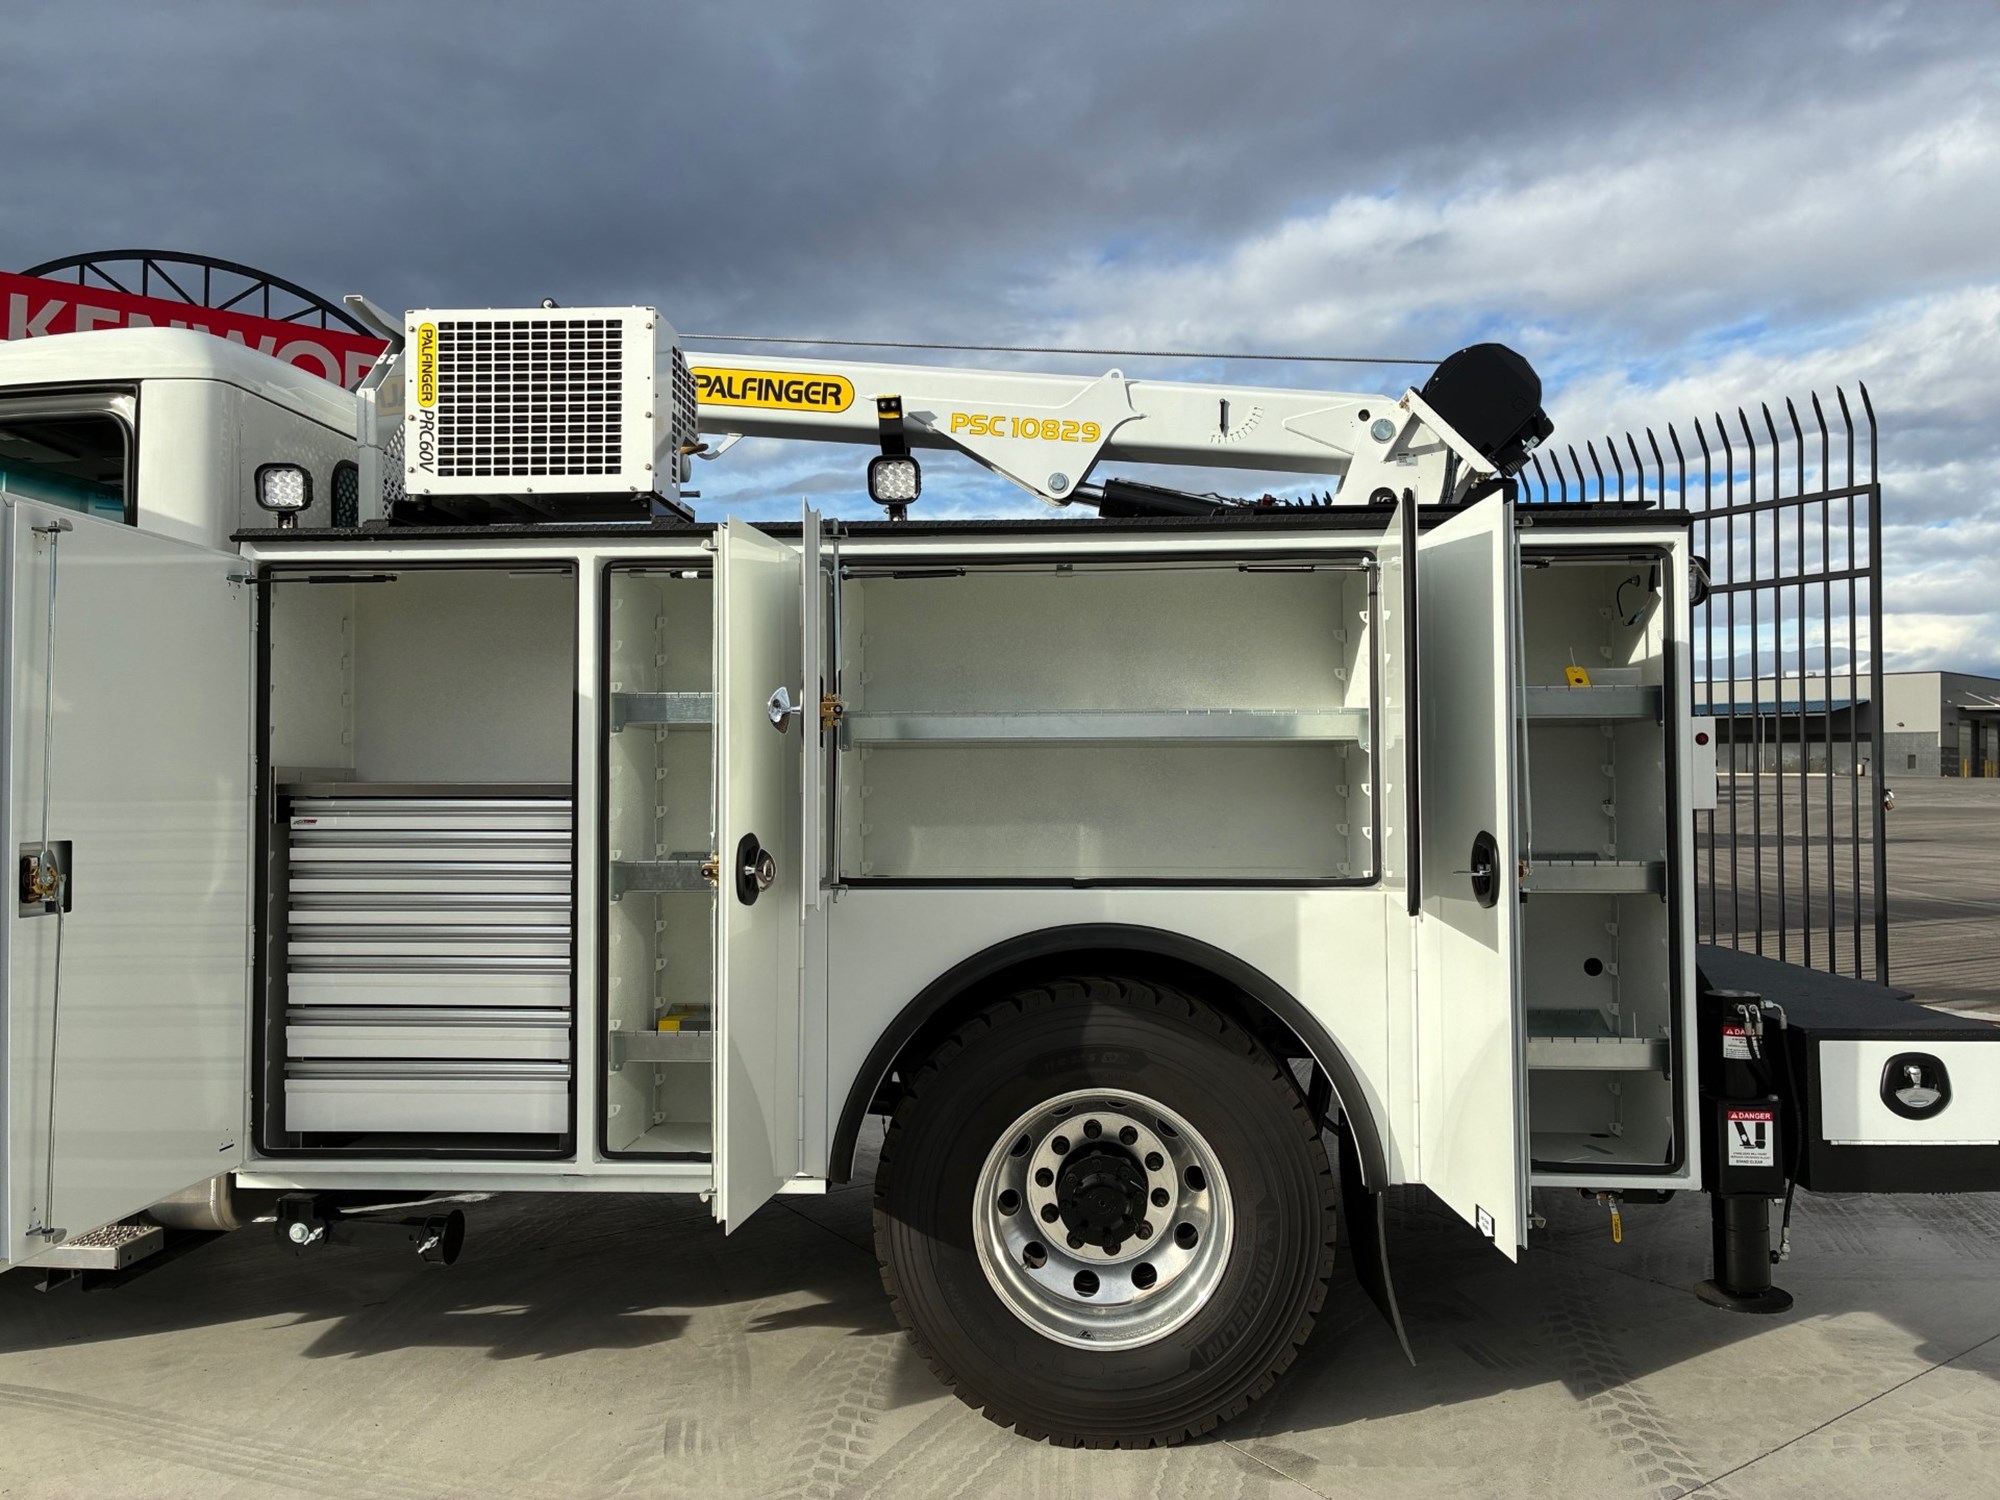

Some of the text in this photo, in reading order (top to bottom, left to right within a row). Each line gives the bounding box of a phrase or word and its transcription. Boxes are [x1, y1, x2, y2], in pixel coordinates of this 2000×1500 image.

[419, 329, 434, 474] PALFINGER PRC60V
[696, 374, 842, 406] PALFINGER
[950, 412, 1101, 443] PSC 10829
[1738, 1112, 1771, 1120] DANGER
[1205, 1249, 1276, 1364] MICHELIN
